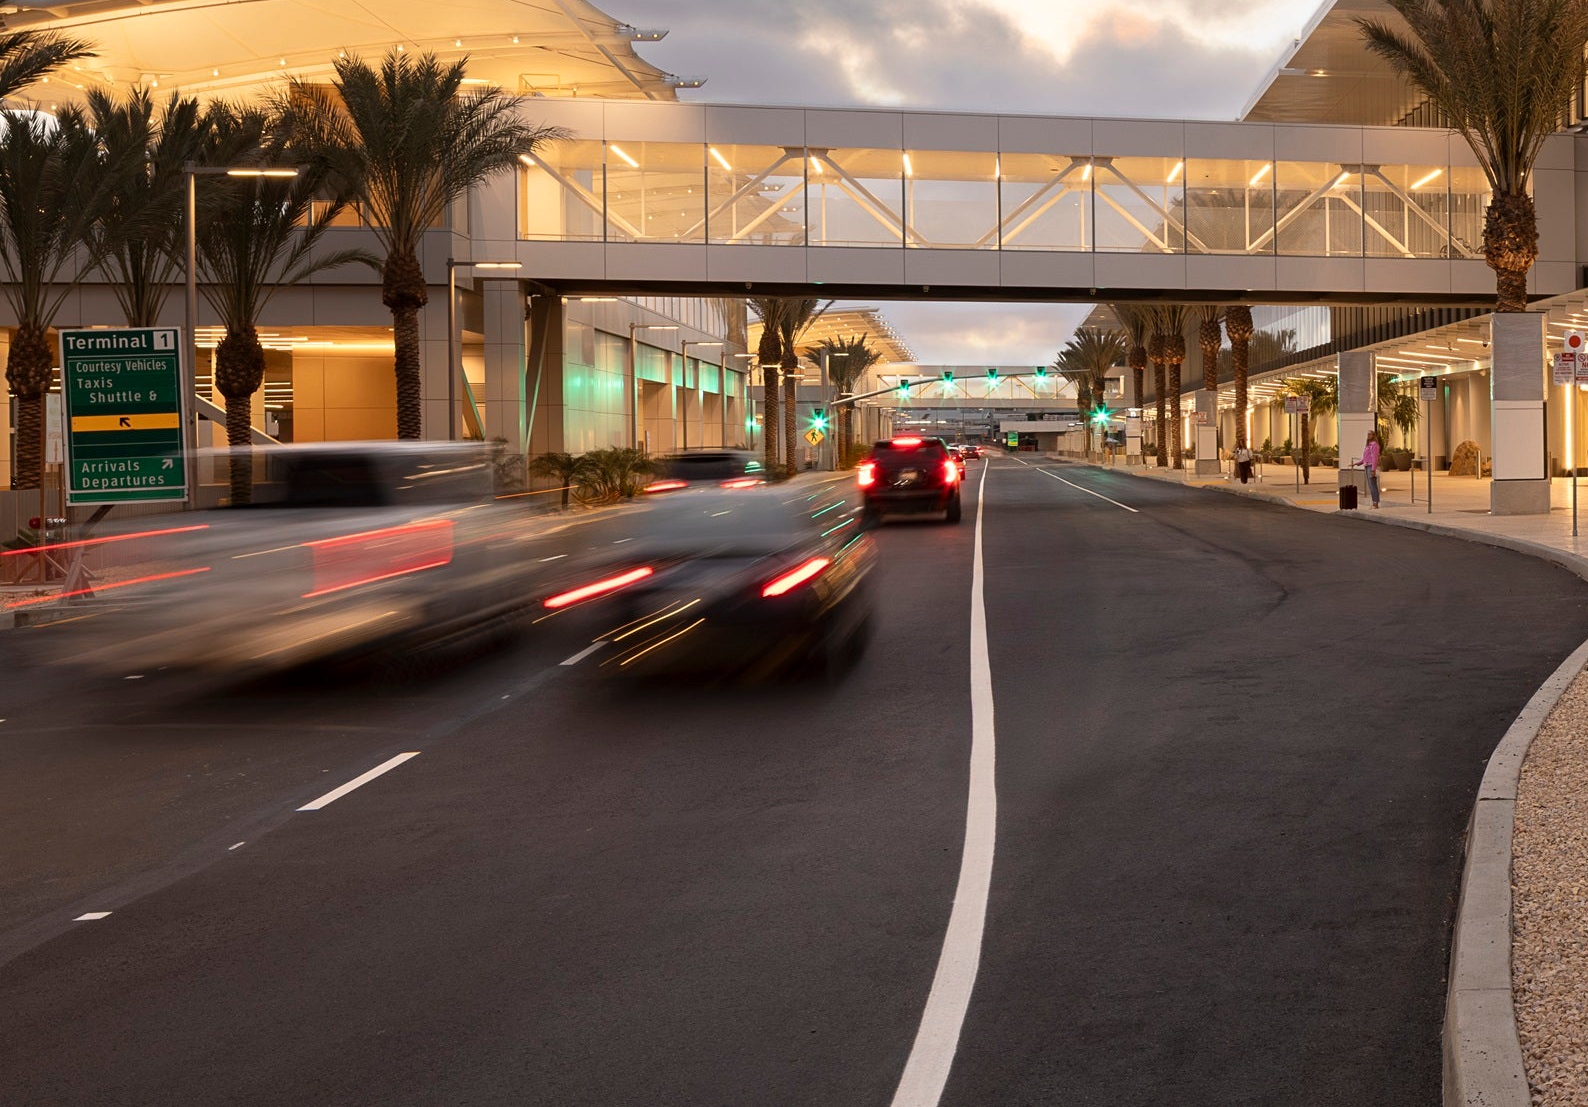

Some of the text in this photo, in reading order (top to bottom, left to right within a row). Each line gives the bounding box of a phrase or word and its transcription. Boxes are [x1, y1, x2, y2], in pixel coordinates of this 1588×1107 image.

[66, 333, 168, 350] Terminal 1
[76, 360, 167, 374] Courtesy Vehicles
[77, 377, 113, 389] Taxis
[89, 390, 157, 403] Shuttle &
[82, 460, 140, 473] Arrivals
[82, 474, 165, 489] Departures
